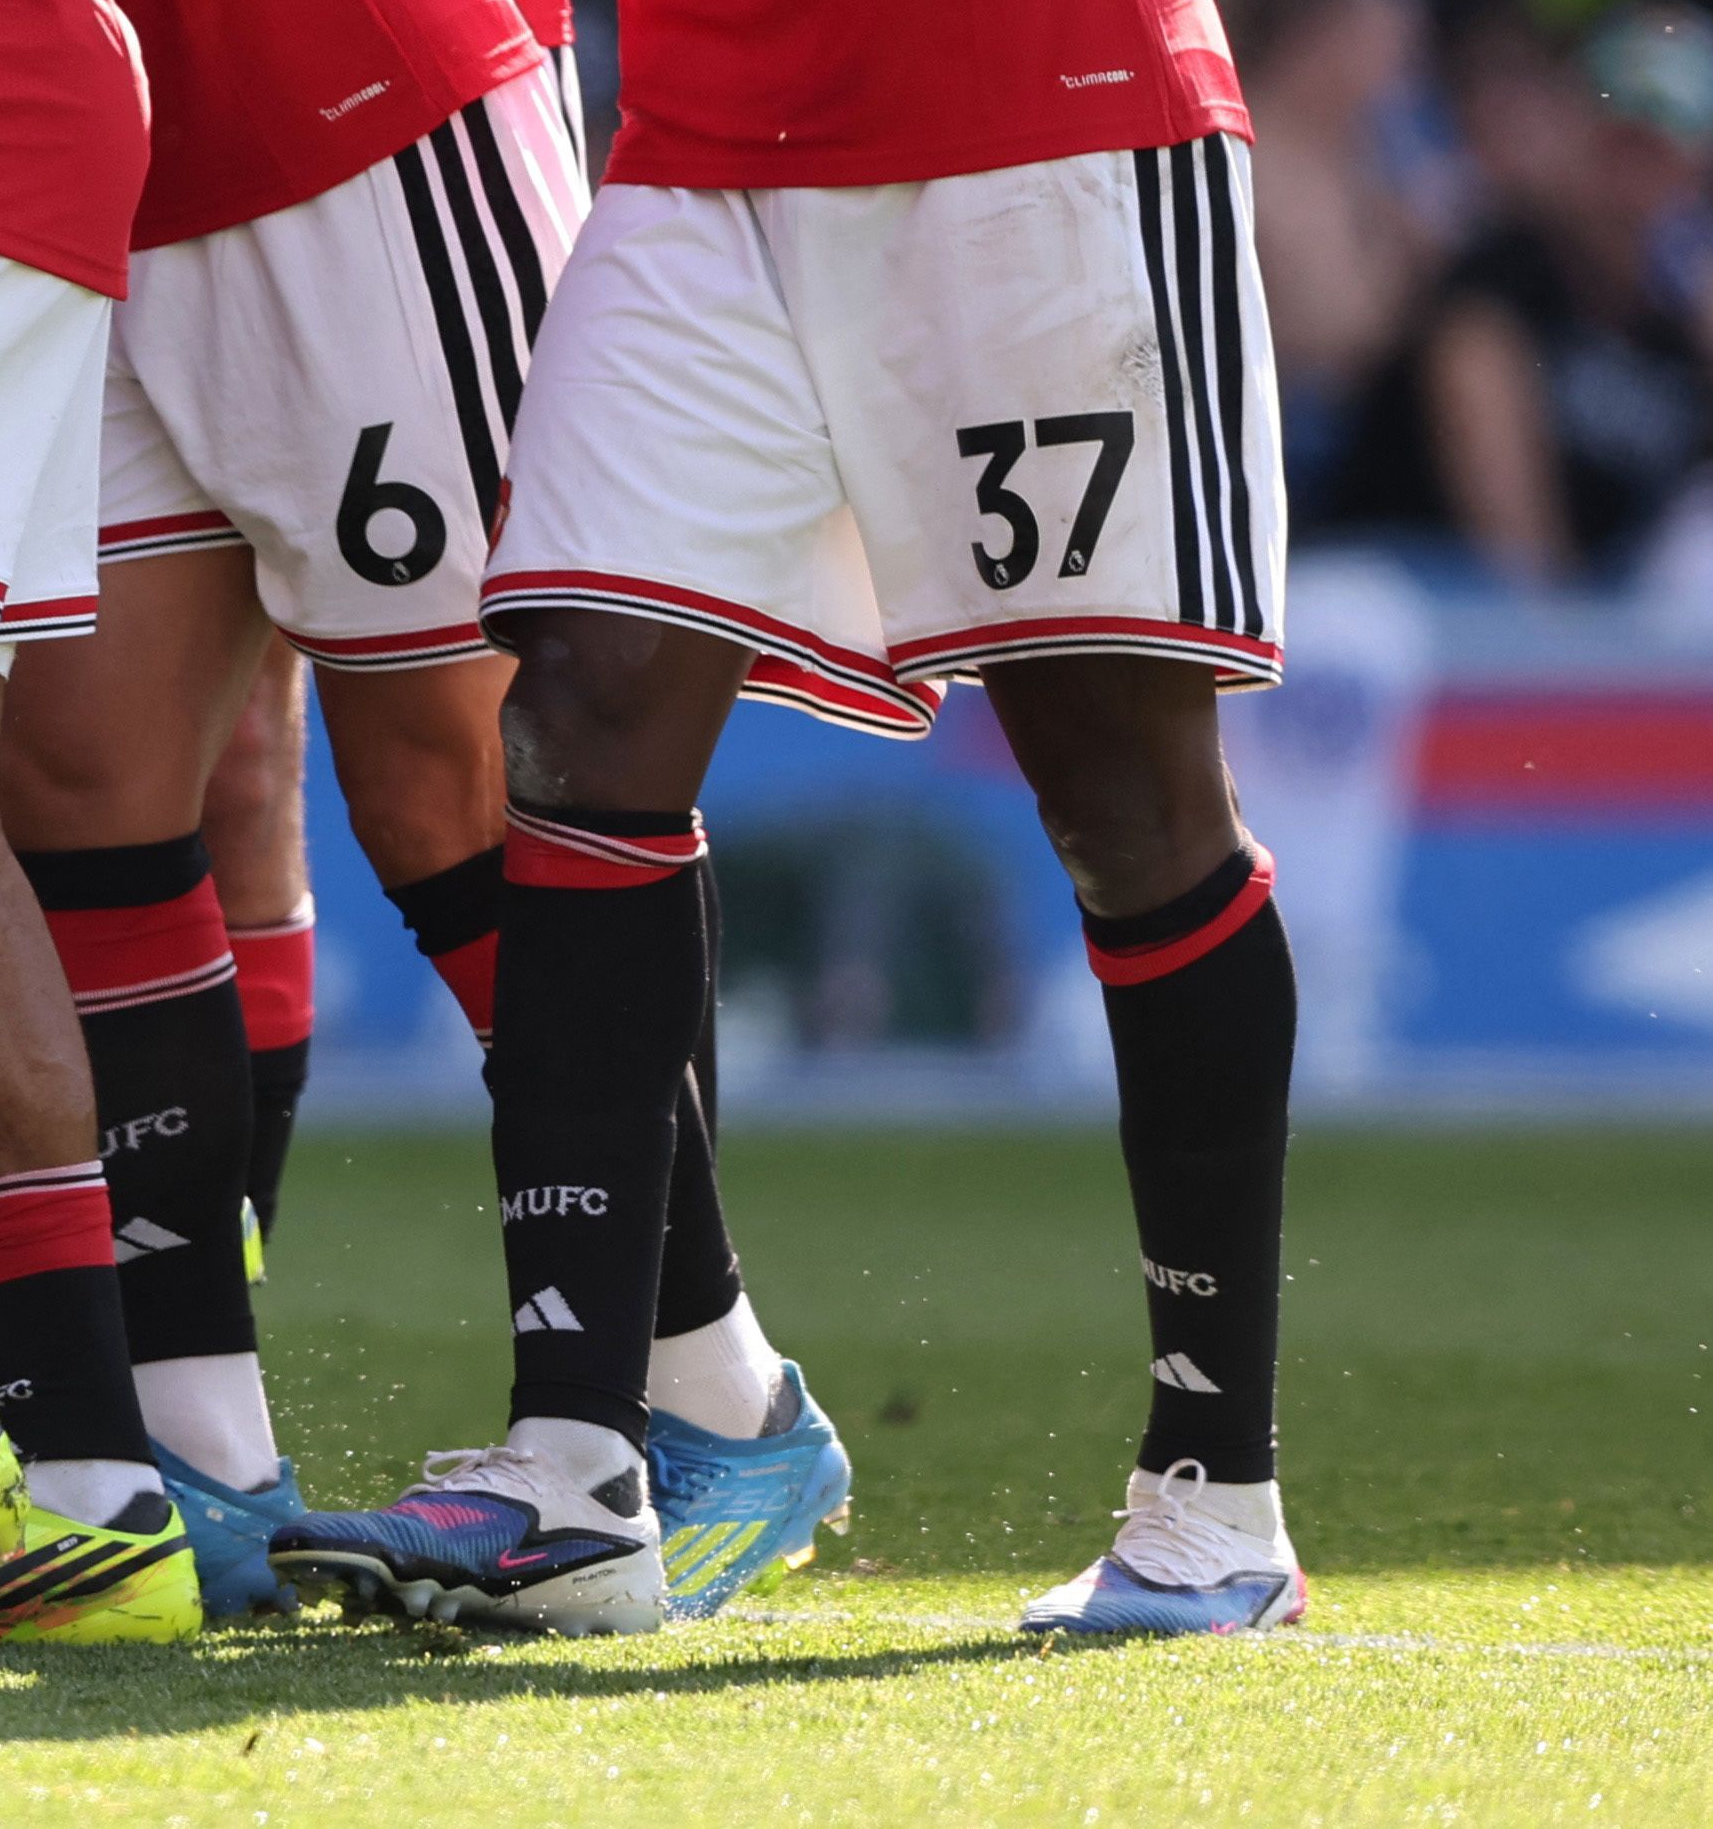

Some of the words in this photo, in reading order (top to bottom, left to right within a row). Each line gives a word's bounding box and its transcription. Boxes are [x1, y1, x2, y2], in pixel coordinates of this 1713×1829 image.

[336, 422, 446, 586] 6
[956, 411, 1135, 590] 37
[501, 1185, 609, 1226] MUFC
[1140, 1249, 1219, 1297] UFC
